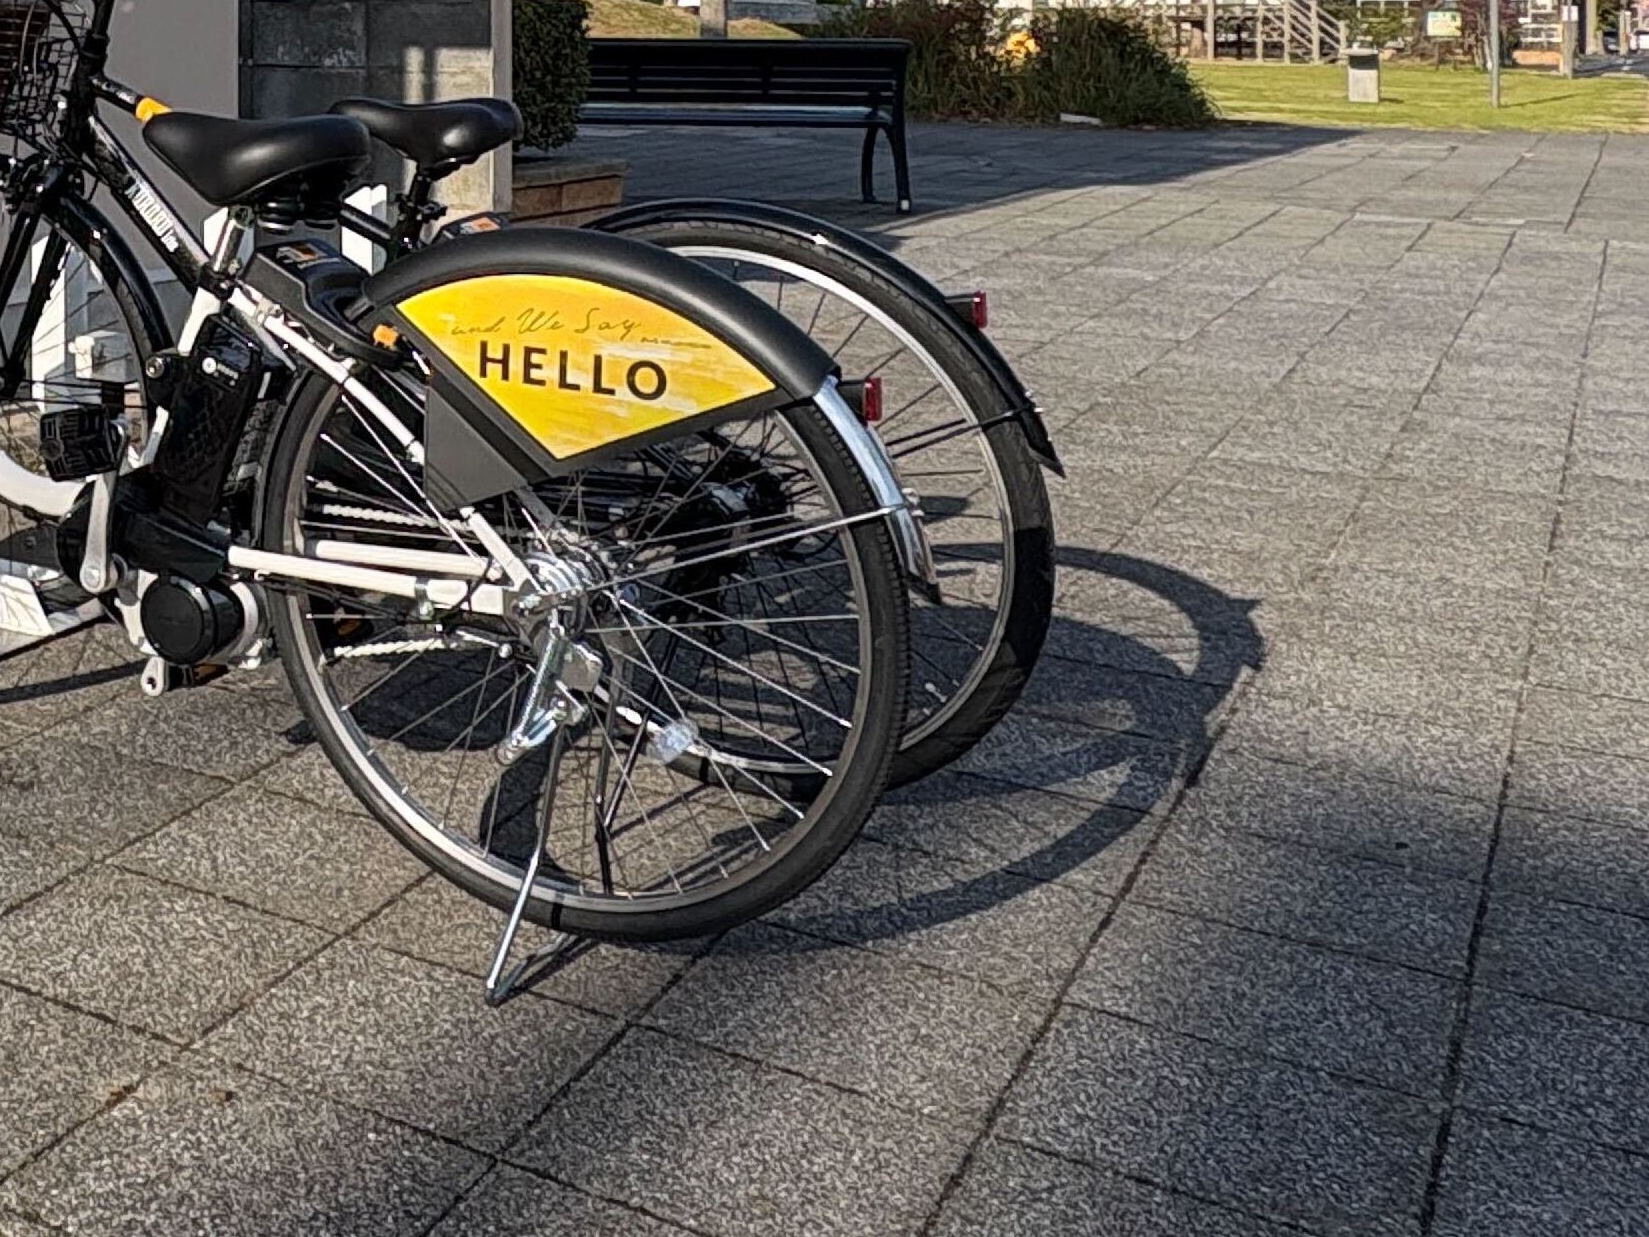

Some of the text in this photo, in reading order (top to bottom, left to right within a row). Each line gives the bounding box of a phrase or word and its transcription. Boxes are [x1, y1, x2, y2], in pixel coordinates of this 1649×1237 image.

[515, 307, 567, 334] We
[574, 306, 642, 338] Say
[479, 339, 667, 401] HELLO
